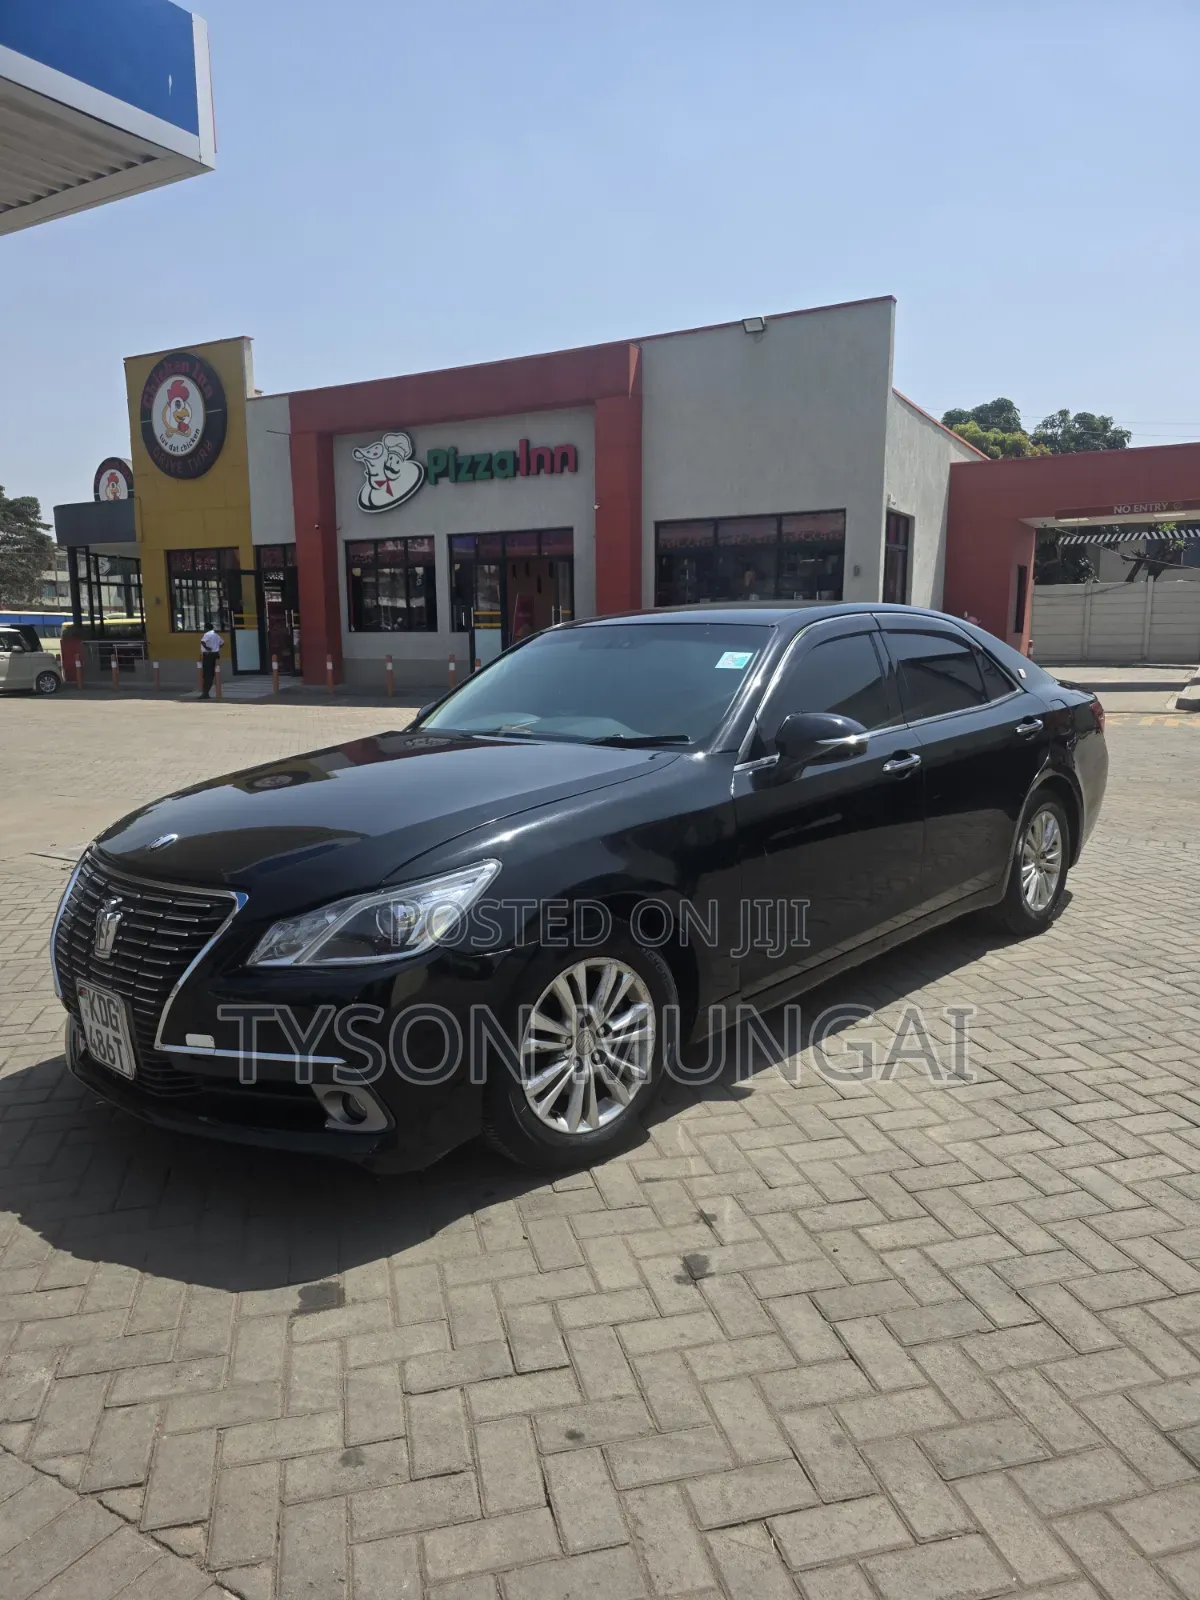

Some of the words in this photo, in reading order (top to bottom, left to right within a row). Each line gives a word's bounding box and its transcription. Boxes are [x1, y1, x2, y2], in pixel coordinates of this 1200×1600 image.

[143, 360, 190, 408] Chicken
[153, 446, 184, 474] DRIVE
[169, 443, 179, 453] dat
[180, 428, 200, 452] chicken
[427, 446, 517, 485] Pizza
[519, 438, 578, 477] Inn
[1113, 505, 1131, 515] NO
[1133, 502, 1169, 513] ENTRY
[88, 989, 121, 1034] KDG
[89, 1025, 125, 1070] 486T
